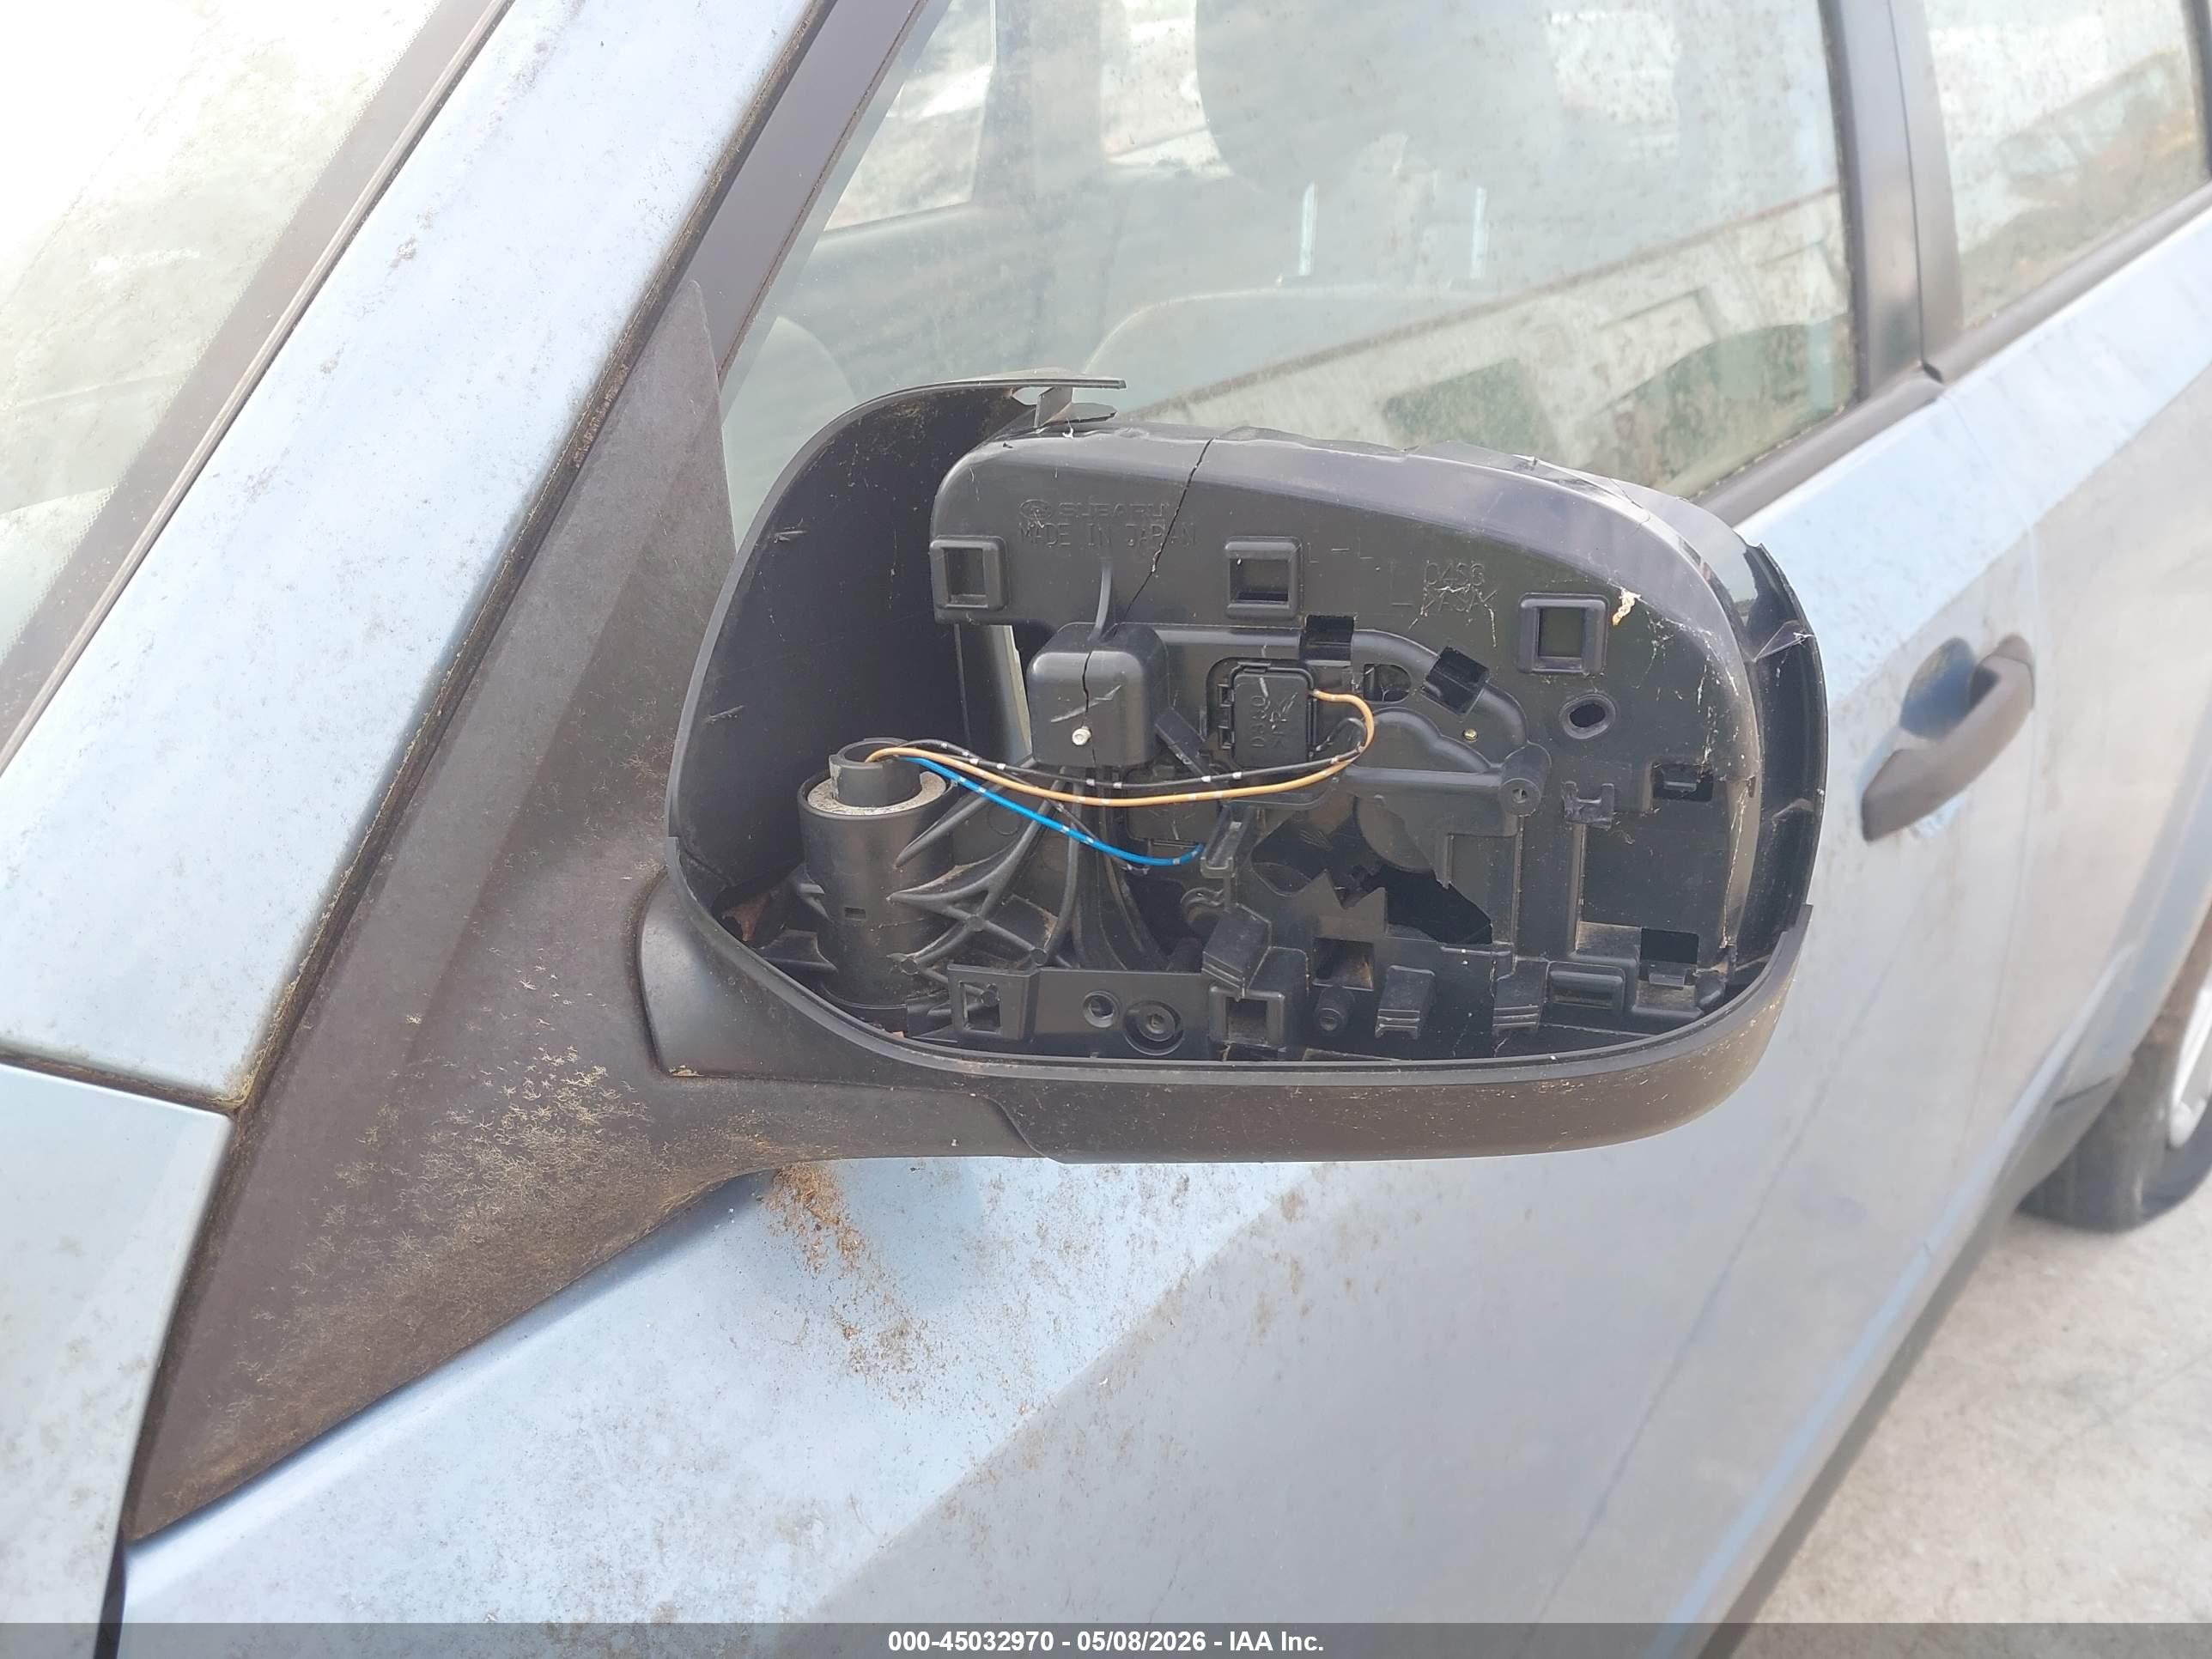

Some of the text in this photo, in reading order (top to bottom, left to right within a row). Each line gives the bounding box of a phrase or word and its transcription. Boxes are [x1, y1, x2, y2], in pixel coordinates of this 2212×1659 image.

[1058, 501, 1170, 520] SUBARU
[1018, 521, 1196, 547] MADE IN JAPAN
